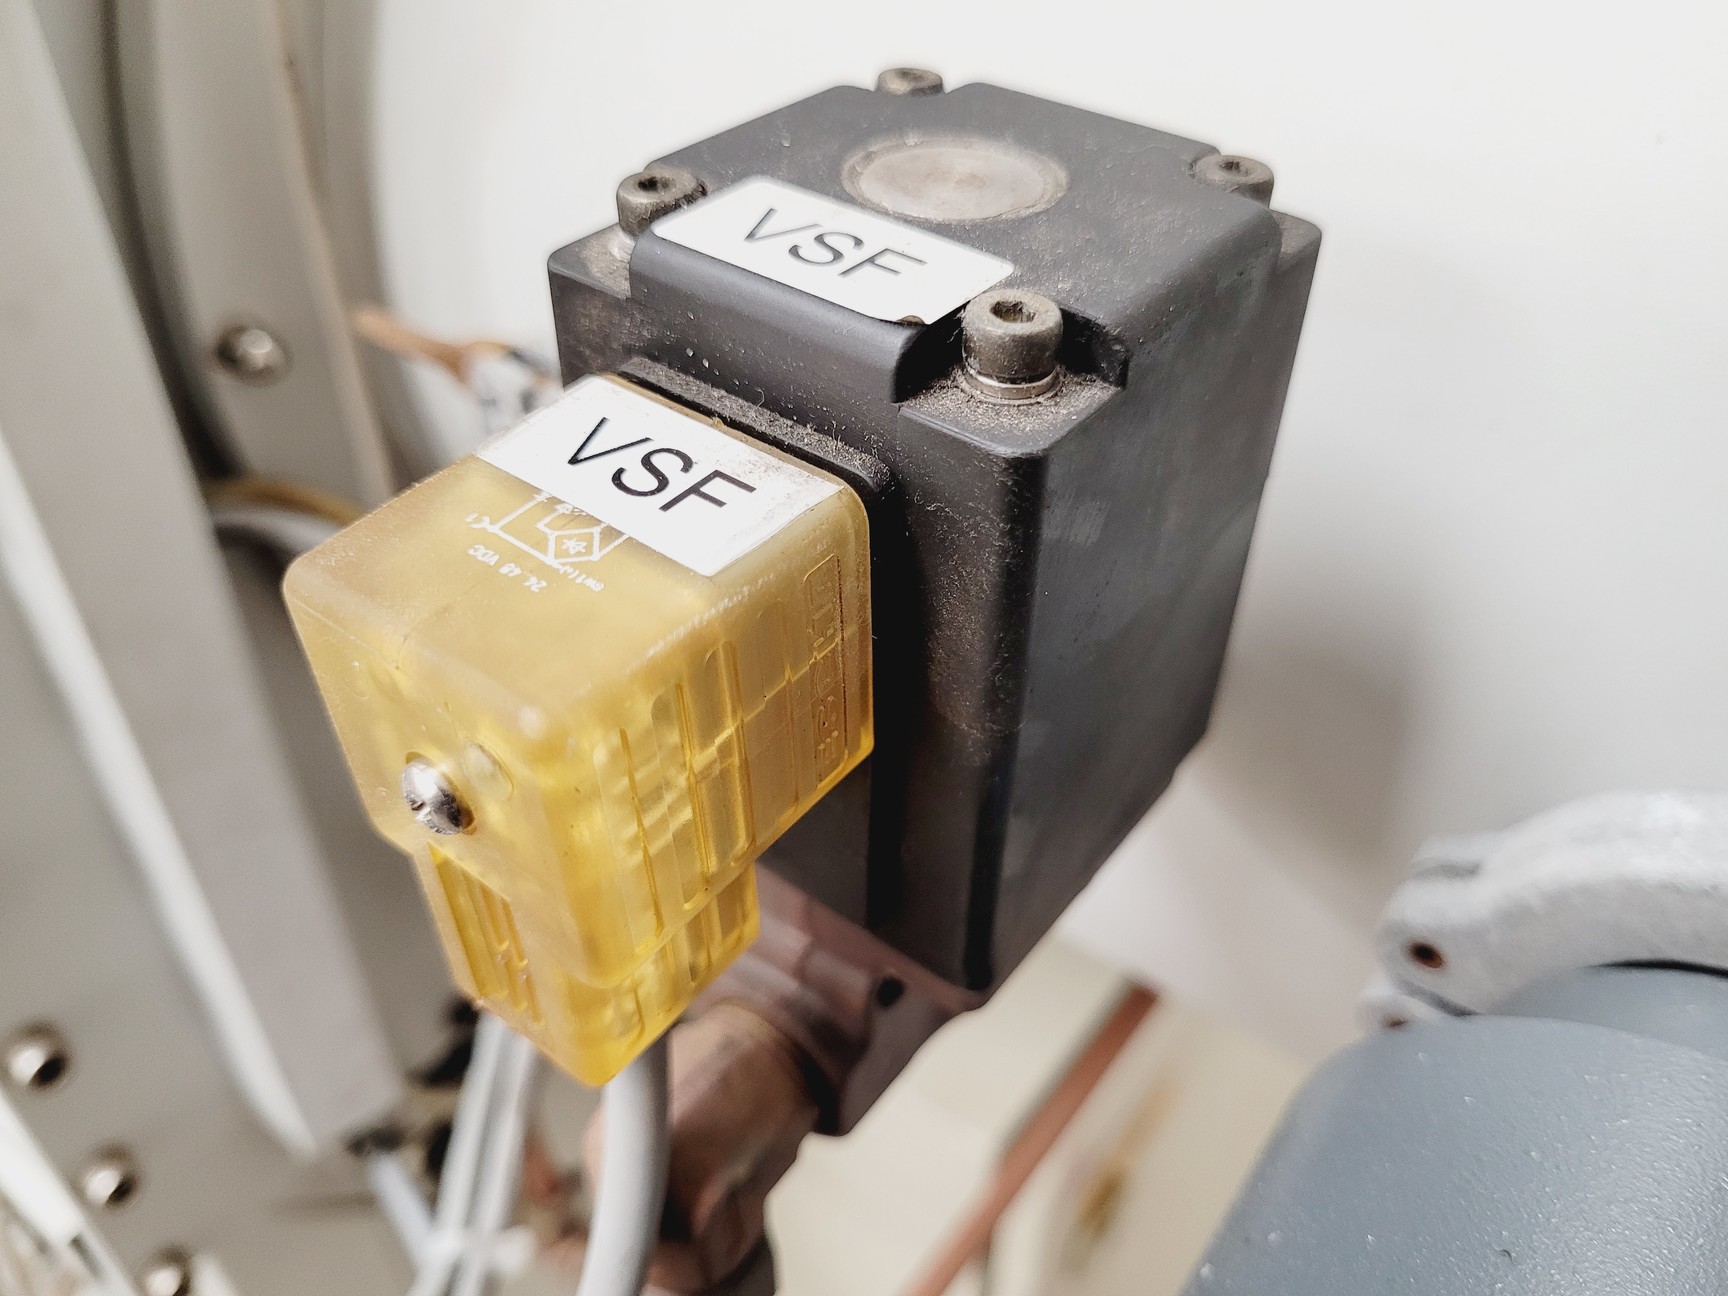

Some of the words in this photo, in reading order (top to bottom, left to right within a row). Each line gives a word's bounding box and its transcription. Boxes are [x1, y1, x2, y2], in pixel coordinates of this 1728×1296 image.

[743, 207, 928, 279] VSF
[567, 416, 757, 513] VSF
[467, 544, 500, 566] VDC
